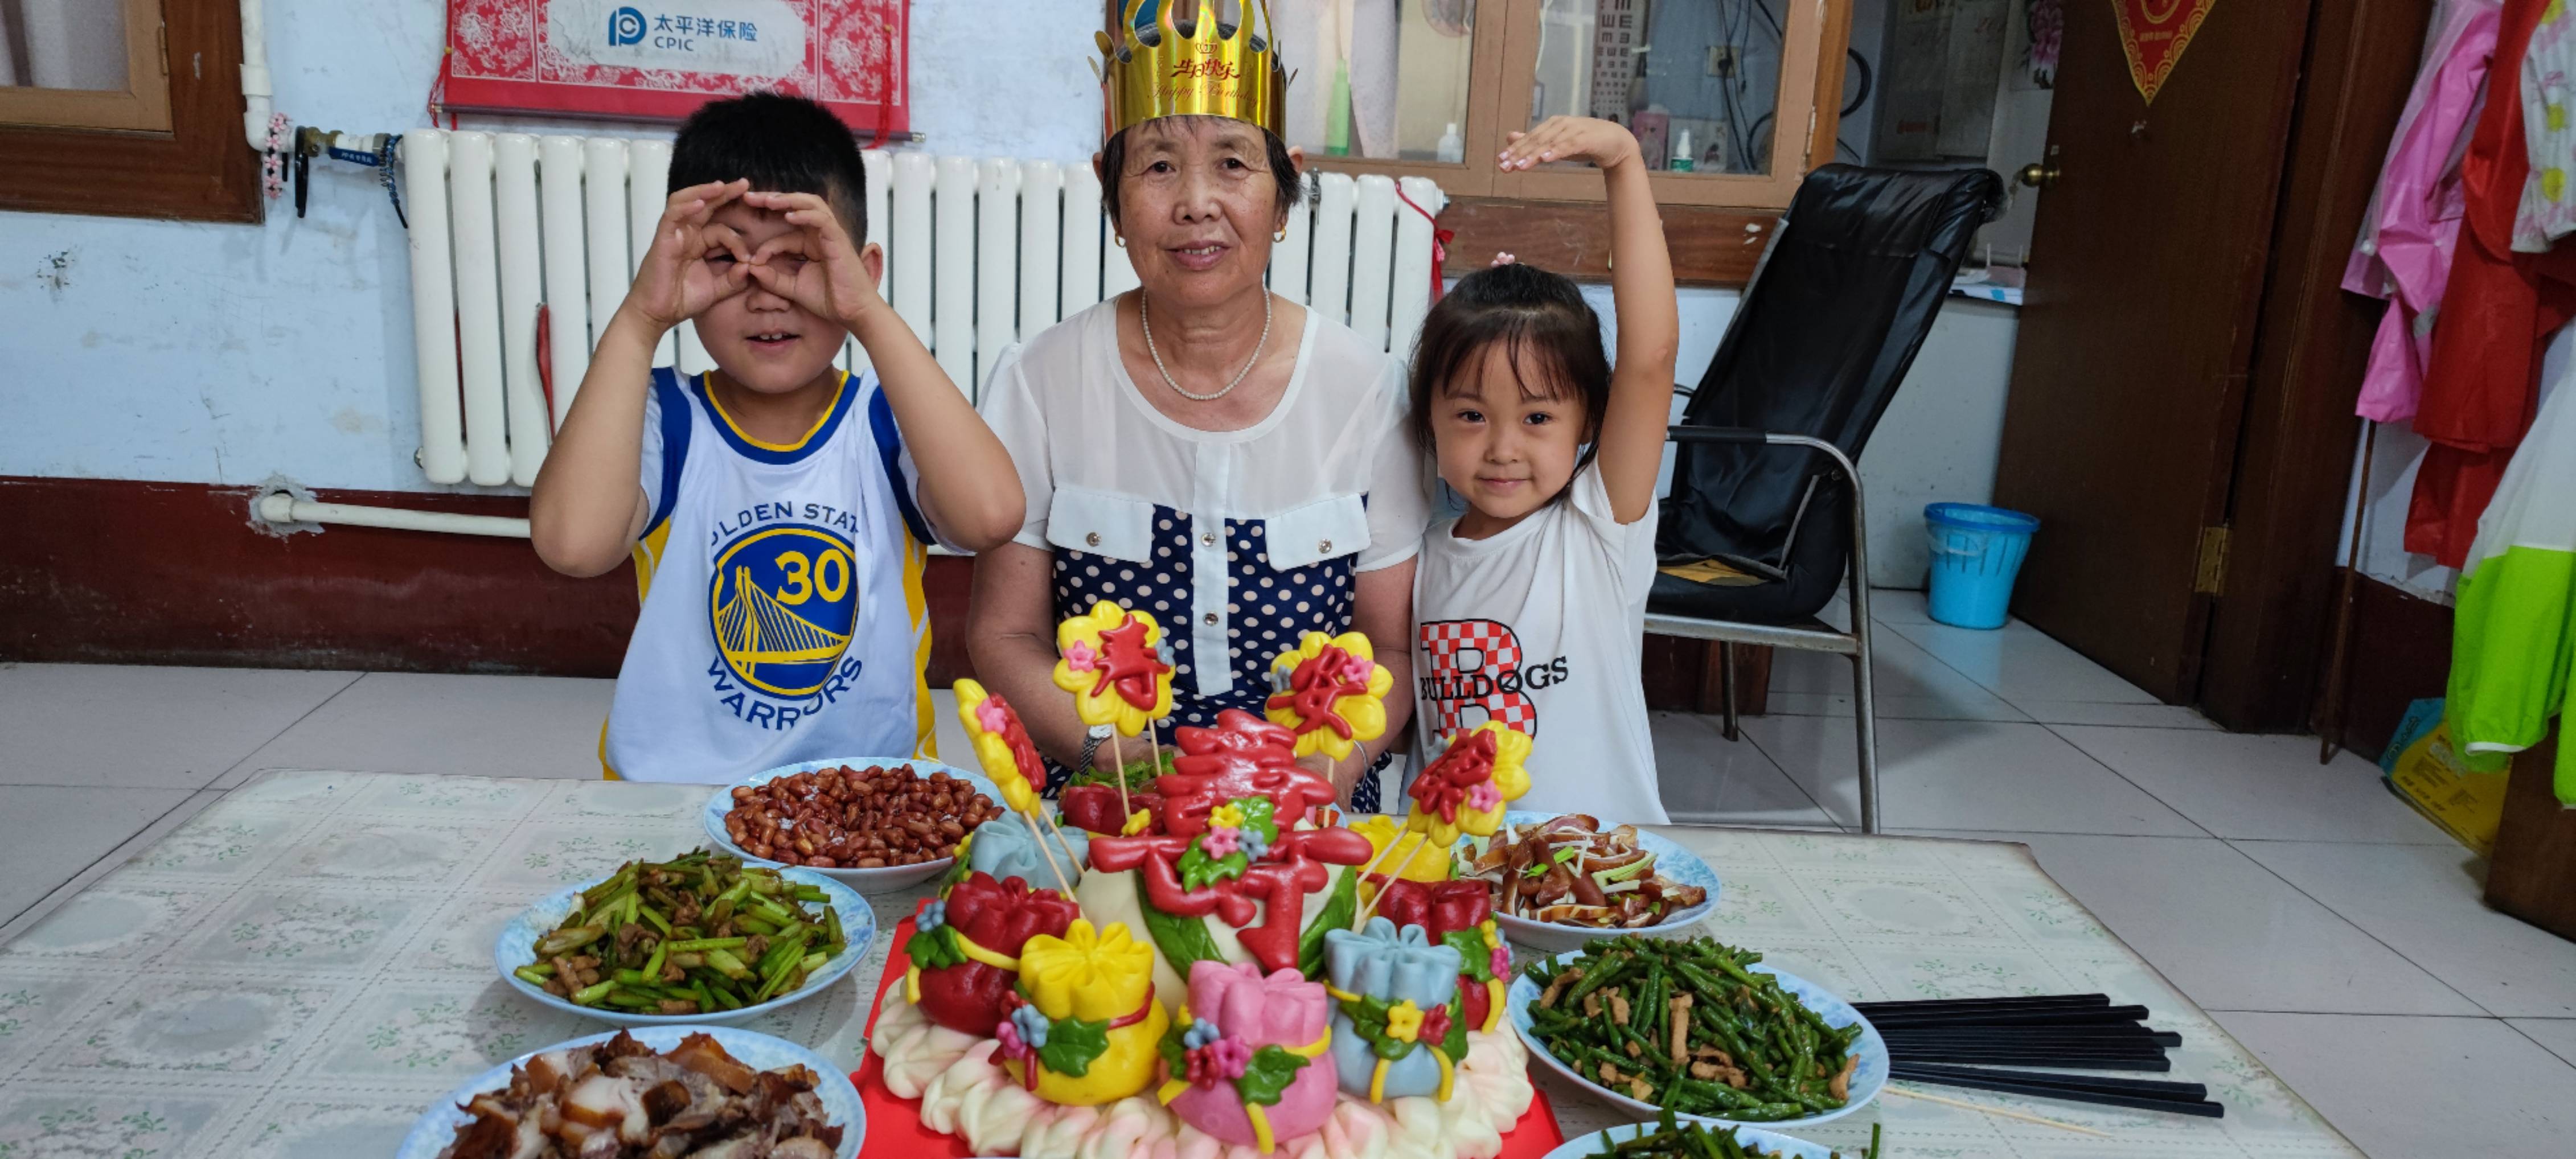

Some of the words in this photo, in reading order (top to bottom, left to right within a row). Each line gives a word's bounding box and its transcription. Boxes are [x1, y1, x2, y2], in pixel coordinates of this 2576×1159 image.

[654, 13, 758, 42] 太平洋保险
[654, 36, 694, 52] CPIC
[1170, 58, 1241, 80] 生日快乐
[711, 500, 793, 546] LDEN
[774, 548, 850, 605] 30
[1420, 655, 1569, 702] BULLDOGS
